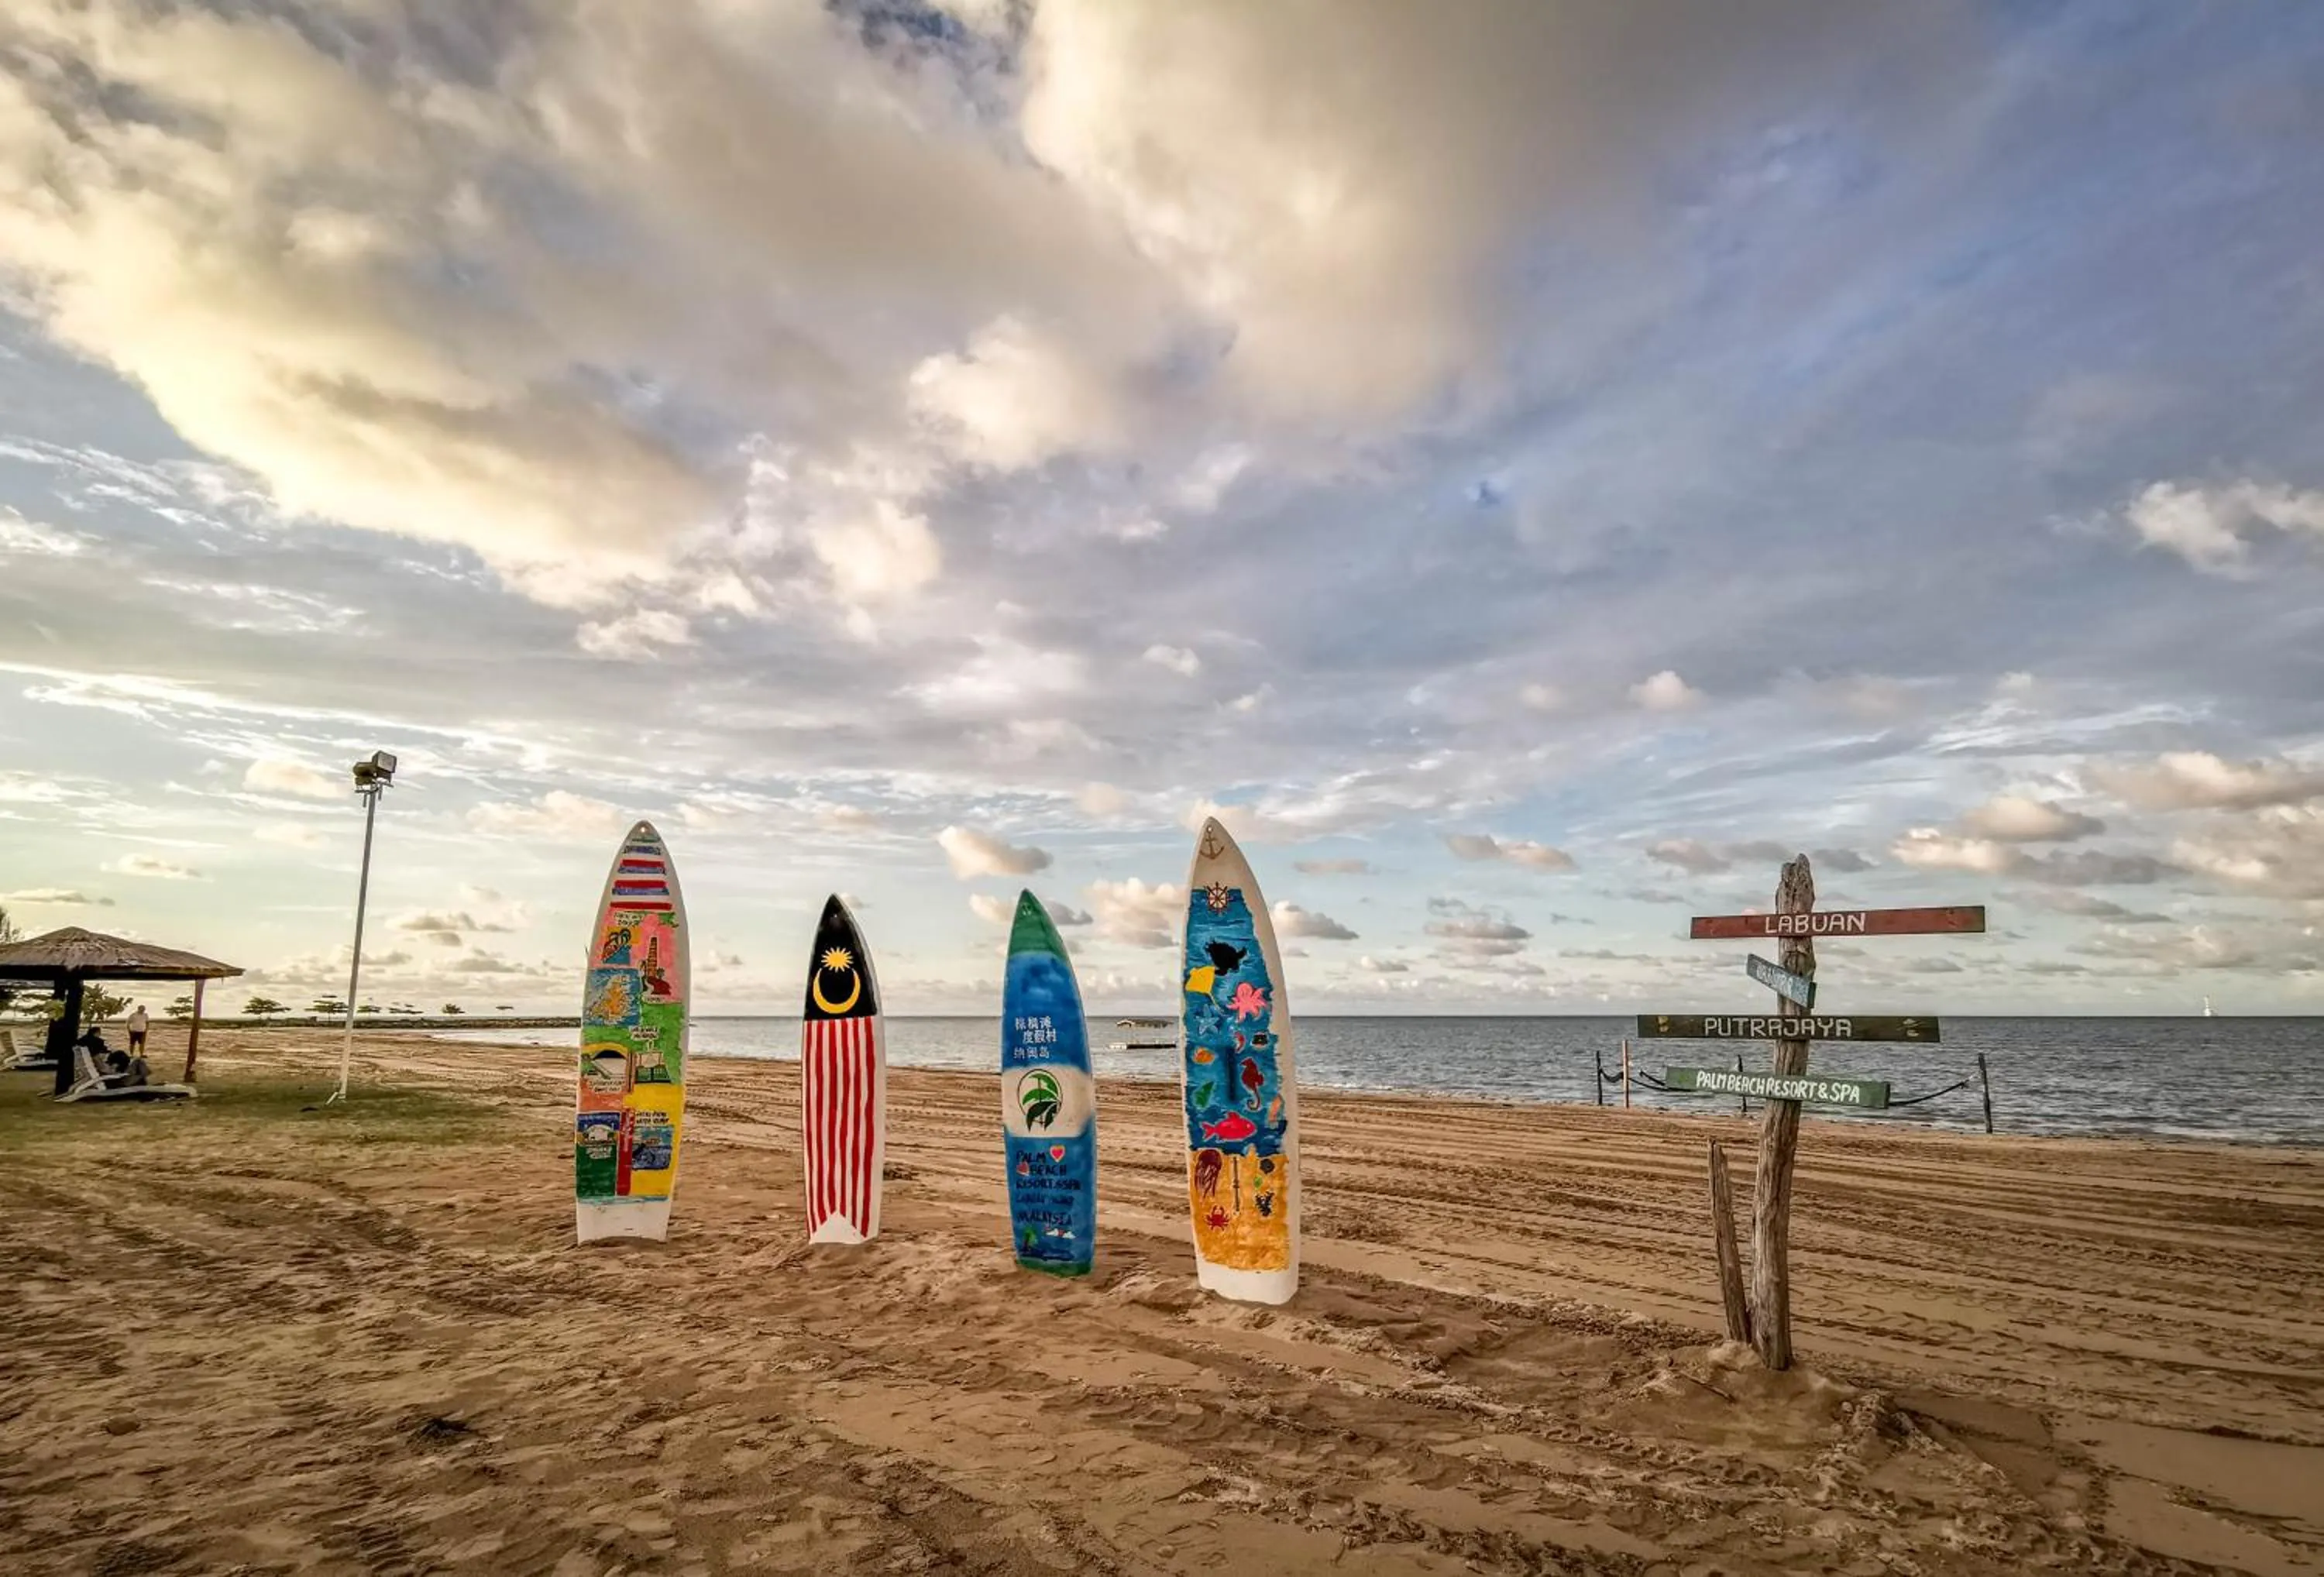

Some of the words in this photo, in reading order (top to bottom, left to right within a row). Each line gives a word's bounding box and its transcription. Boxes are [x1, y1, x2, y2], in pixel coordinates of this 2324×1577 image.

[1765, 912, 1867, 934] LABUAN
[1704, 1016, 1853, 1038] PUTRAJAYA
[1696, 1070, 1727, 1090] PALM
[1727, 1074, 1765, 1095] BEACH
[1765, 1077, 1818, 1099] RESORT
[1817, 1081, 1829, 1099] &
[1829, 1082, 1860, 1104] SPA
[1016, 1150, 1046, 1163] PALM
[1030, 1164, 1067, 1176] BEACH
